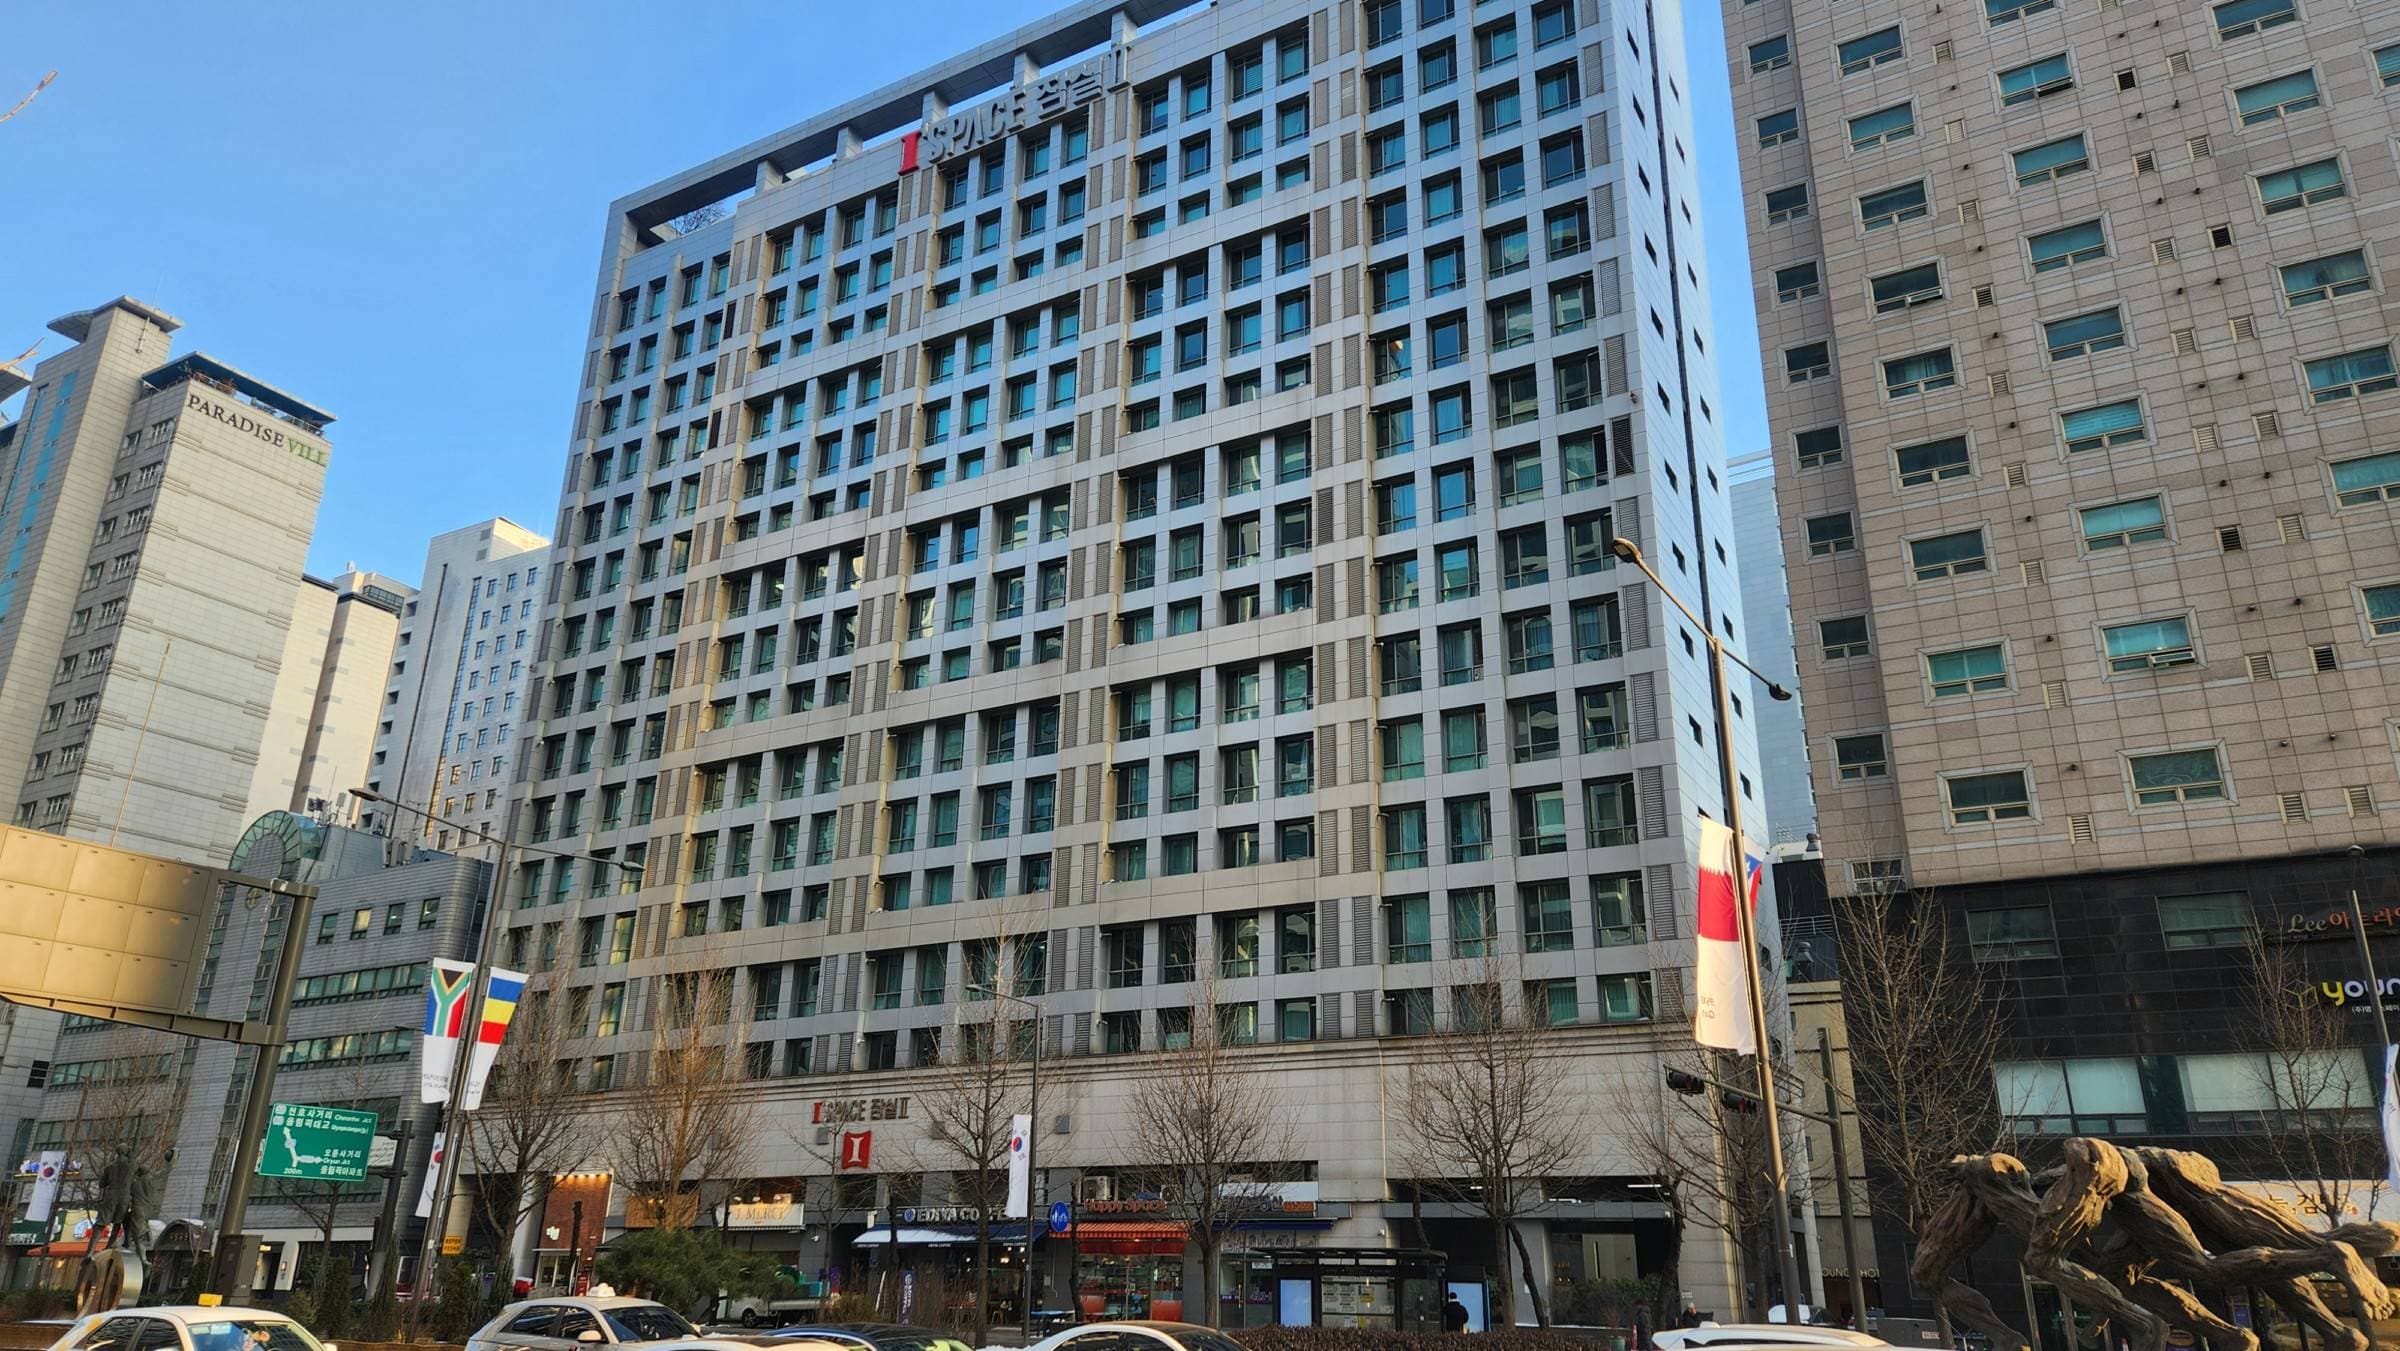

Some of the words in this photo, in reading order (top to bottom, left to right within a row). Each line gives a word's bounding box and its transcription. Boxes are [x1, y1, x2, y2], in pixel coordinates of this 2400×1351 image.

[187, 393, 286, 448] PARADISE
[287, 436, 327, 468] VILL
[2287, 913, 2328, 933] Lee
[916, 1207, 958, 1223] EDIYA
[1084, 1199, 1122, 1213] Happy
